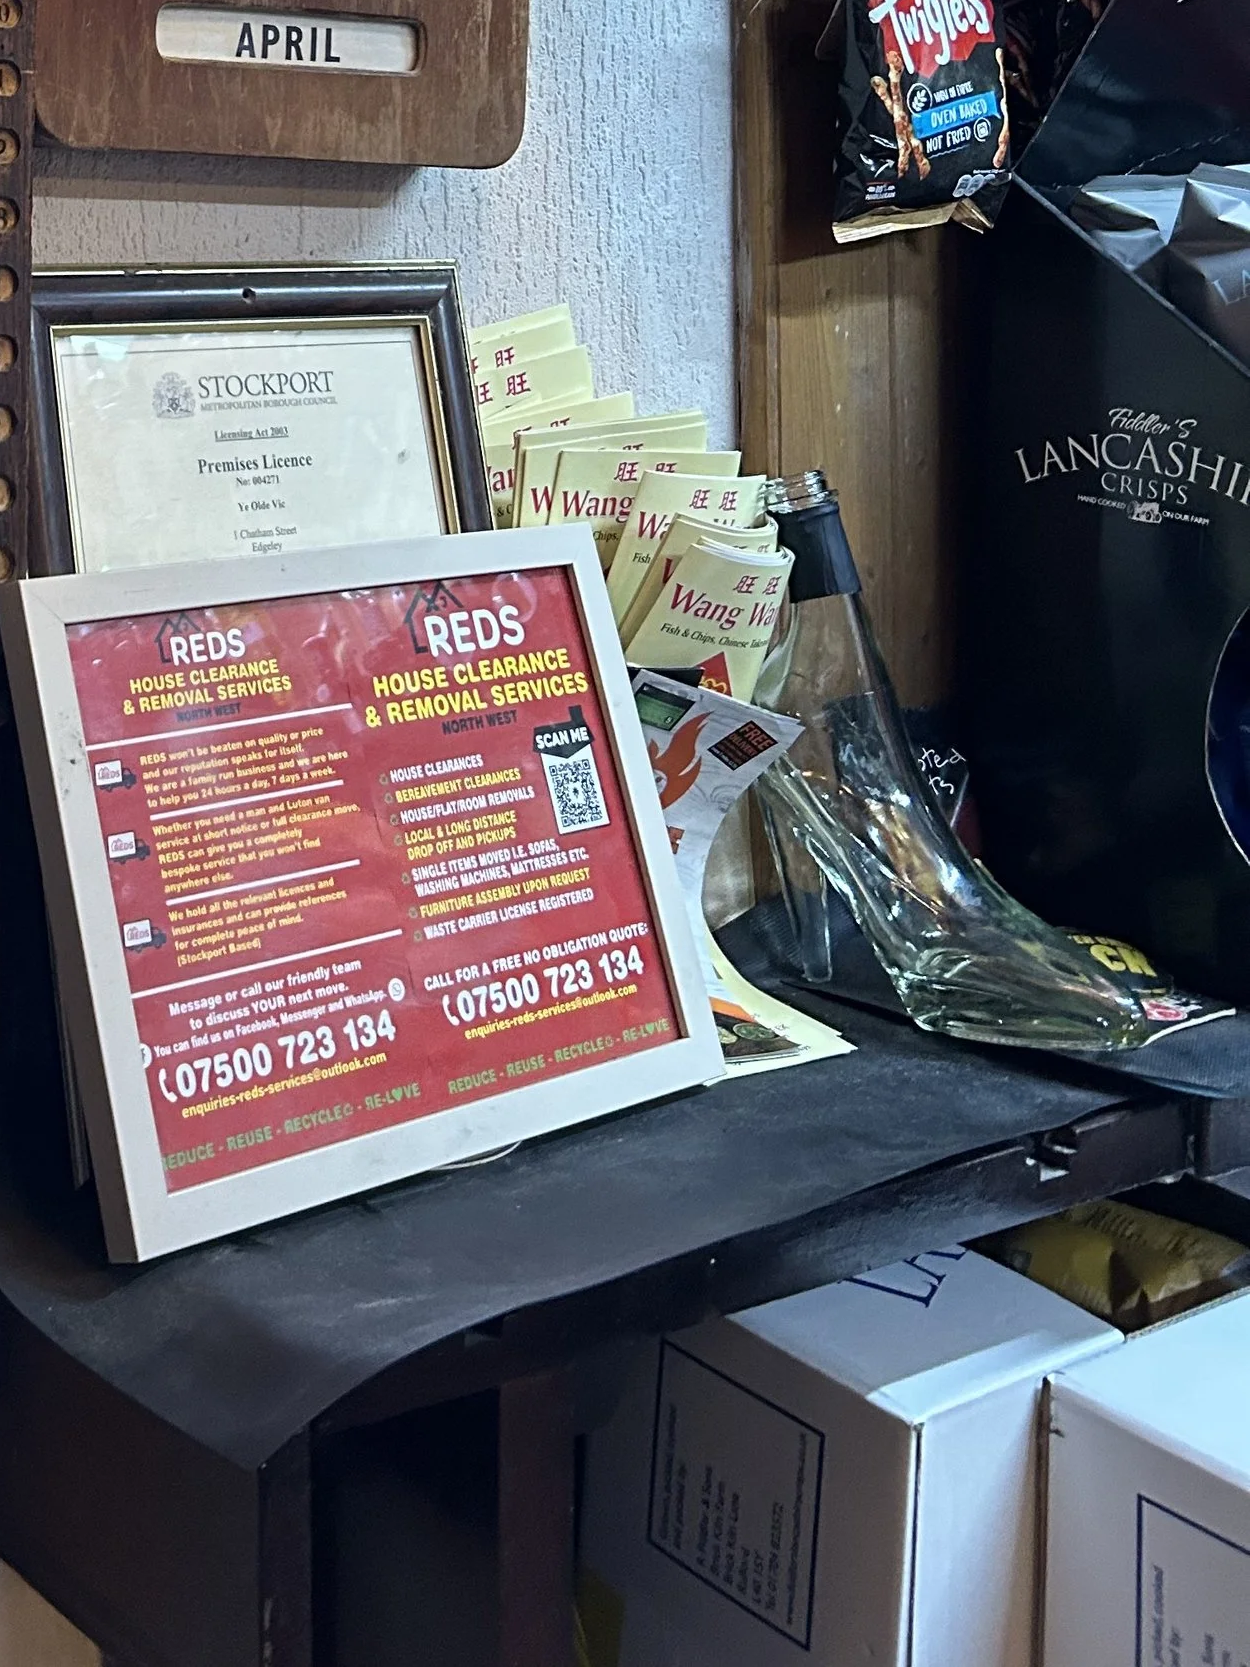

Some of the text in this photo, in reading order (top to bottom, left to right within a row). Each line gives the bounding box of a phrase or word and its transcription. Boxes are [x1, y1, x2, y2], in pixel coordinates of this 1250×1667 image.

[236, 22, 342, 64] APRIL
[930, 106, 958, 129] OVEN
[925, 124, 972, 154] NOT FRIED
[197, 370, 335, 399] STOCKPORT
[214, 426, 253, 442] Licensing
[255, 426, 270, 439] Act
[197, 453, 313, 475] Premises Licence
[561, 488, 636, 524] Wang
[1077, 493, 1097, 505] HAND
[1097, 496, 1127, 510] COOKED
[1100, 471, 1188, 505] CRISPS
[669, 581, 745, 630] Wang
[423, 605, 526, 658] REDS
[660, 621, 681, 636] Fish
[169, 628, 247, 667] REDS
[129, 657, 280, 694] HOUSE CLEARANCE
[372, 648, 571, 698] HOUSE CLEARANCE
[122, 674, 292, 716] & REMOVAL SERVICES
[365, 671, 589, 729] & REMOVAL SERVICES
[441, 709, 518, 735] NORTH WEST
[535, 727, 590, 750] SCAN ME
[390, 753, 484, 783] HOUSE CLEARANCES
[395, 767, 522, 804] BEREAVEMENT CLEARANCES
[489, 785, 536, 807] REMOVALS
[423, 921, 650, 991] CALL FOR A FREE NO OBLIGATION QUOTE:
[456, 944, 645, 1023] 07500 723 134
[176, 1009, 397, 1098] 07500 723 134
